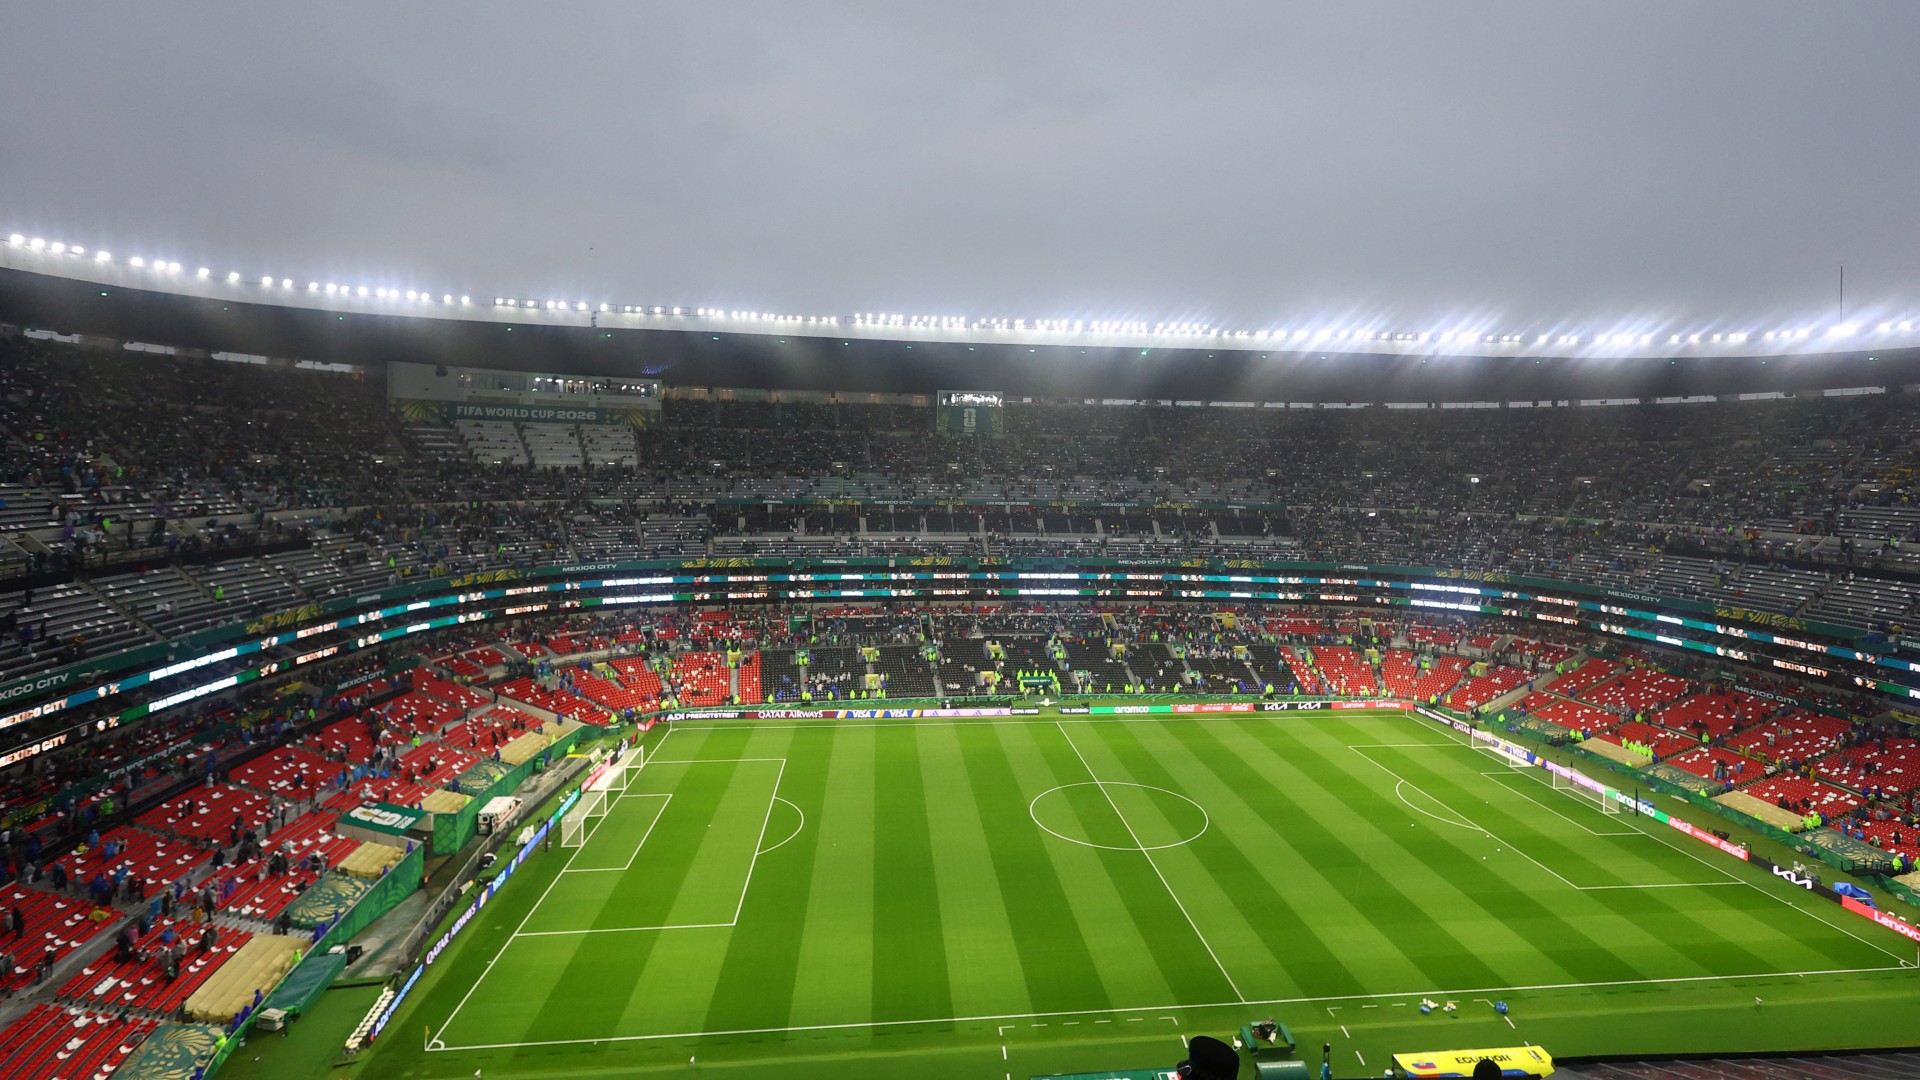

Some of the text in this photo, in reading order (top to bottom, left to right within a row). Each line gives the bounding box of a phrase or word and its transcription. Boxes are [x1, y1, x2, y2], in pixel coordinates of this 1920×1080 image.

[457, 406, 596, 420] FIFA WORLD CUP 2026
[1608, 590, 1661, 603] MEXICO CITY
[1773, 636, 1829, 653] MEXICO CITY
[1773, 660, 1829, 678] MEXICO CITY
[36, 673, 69, 689] CITY
[337, 669, 386, 690] MEXICO CITY
[1735, 685, 1774, 699] MEXICO
[43, 698, 68, 714] CITY
[666, 713, 685, 721] ADI
[1453, 722, 1470, 735] QATAR
[42, 734, 67, 751] CITY
[1616, 792, 1655, 817] aramco
[1874, 911, 1920, 942] Lenovo
